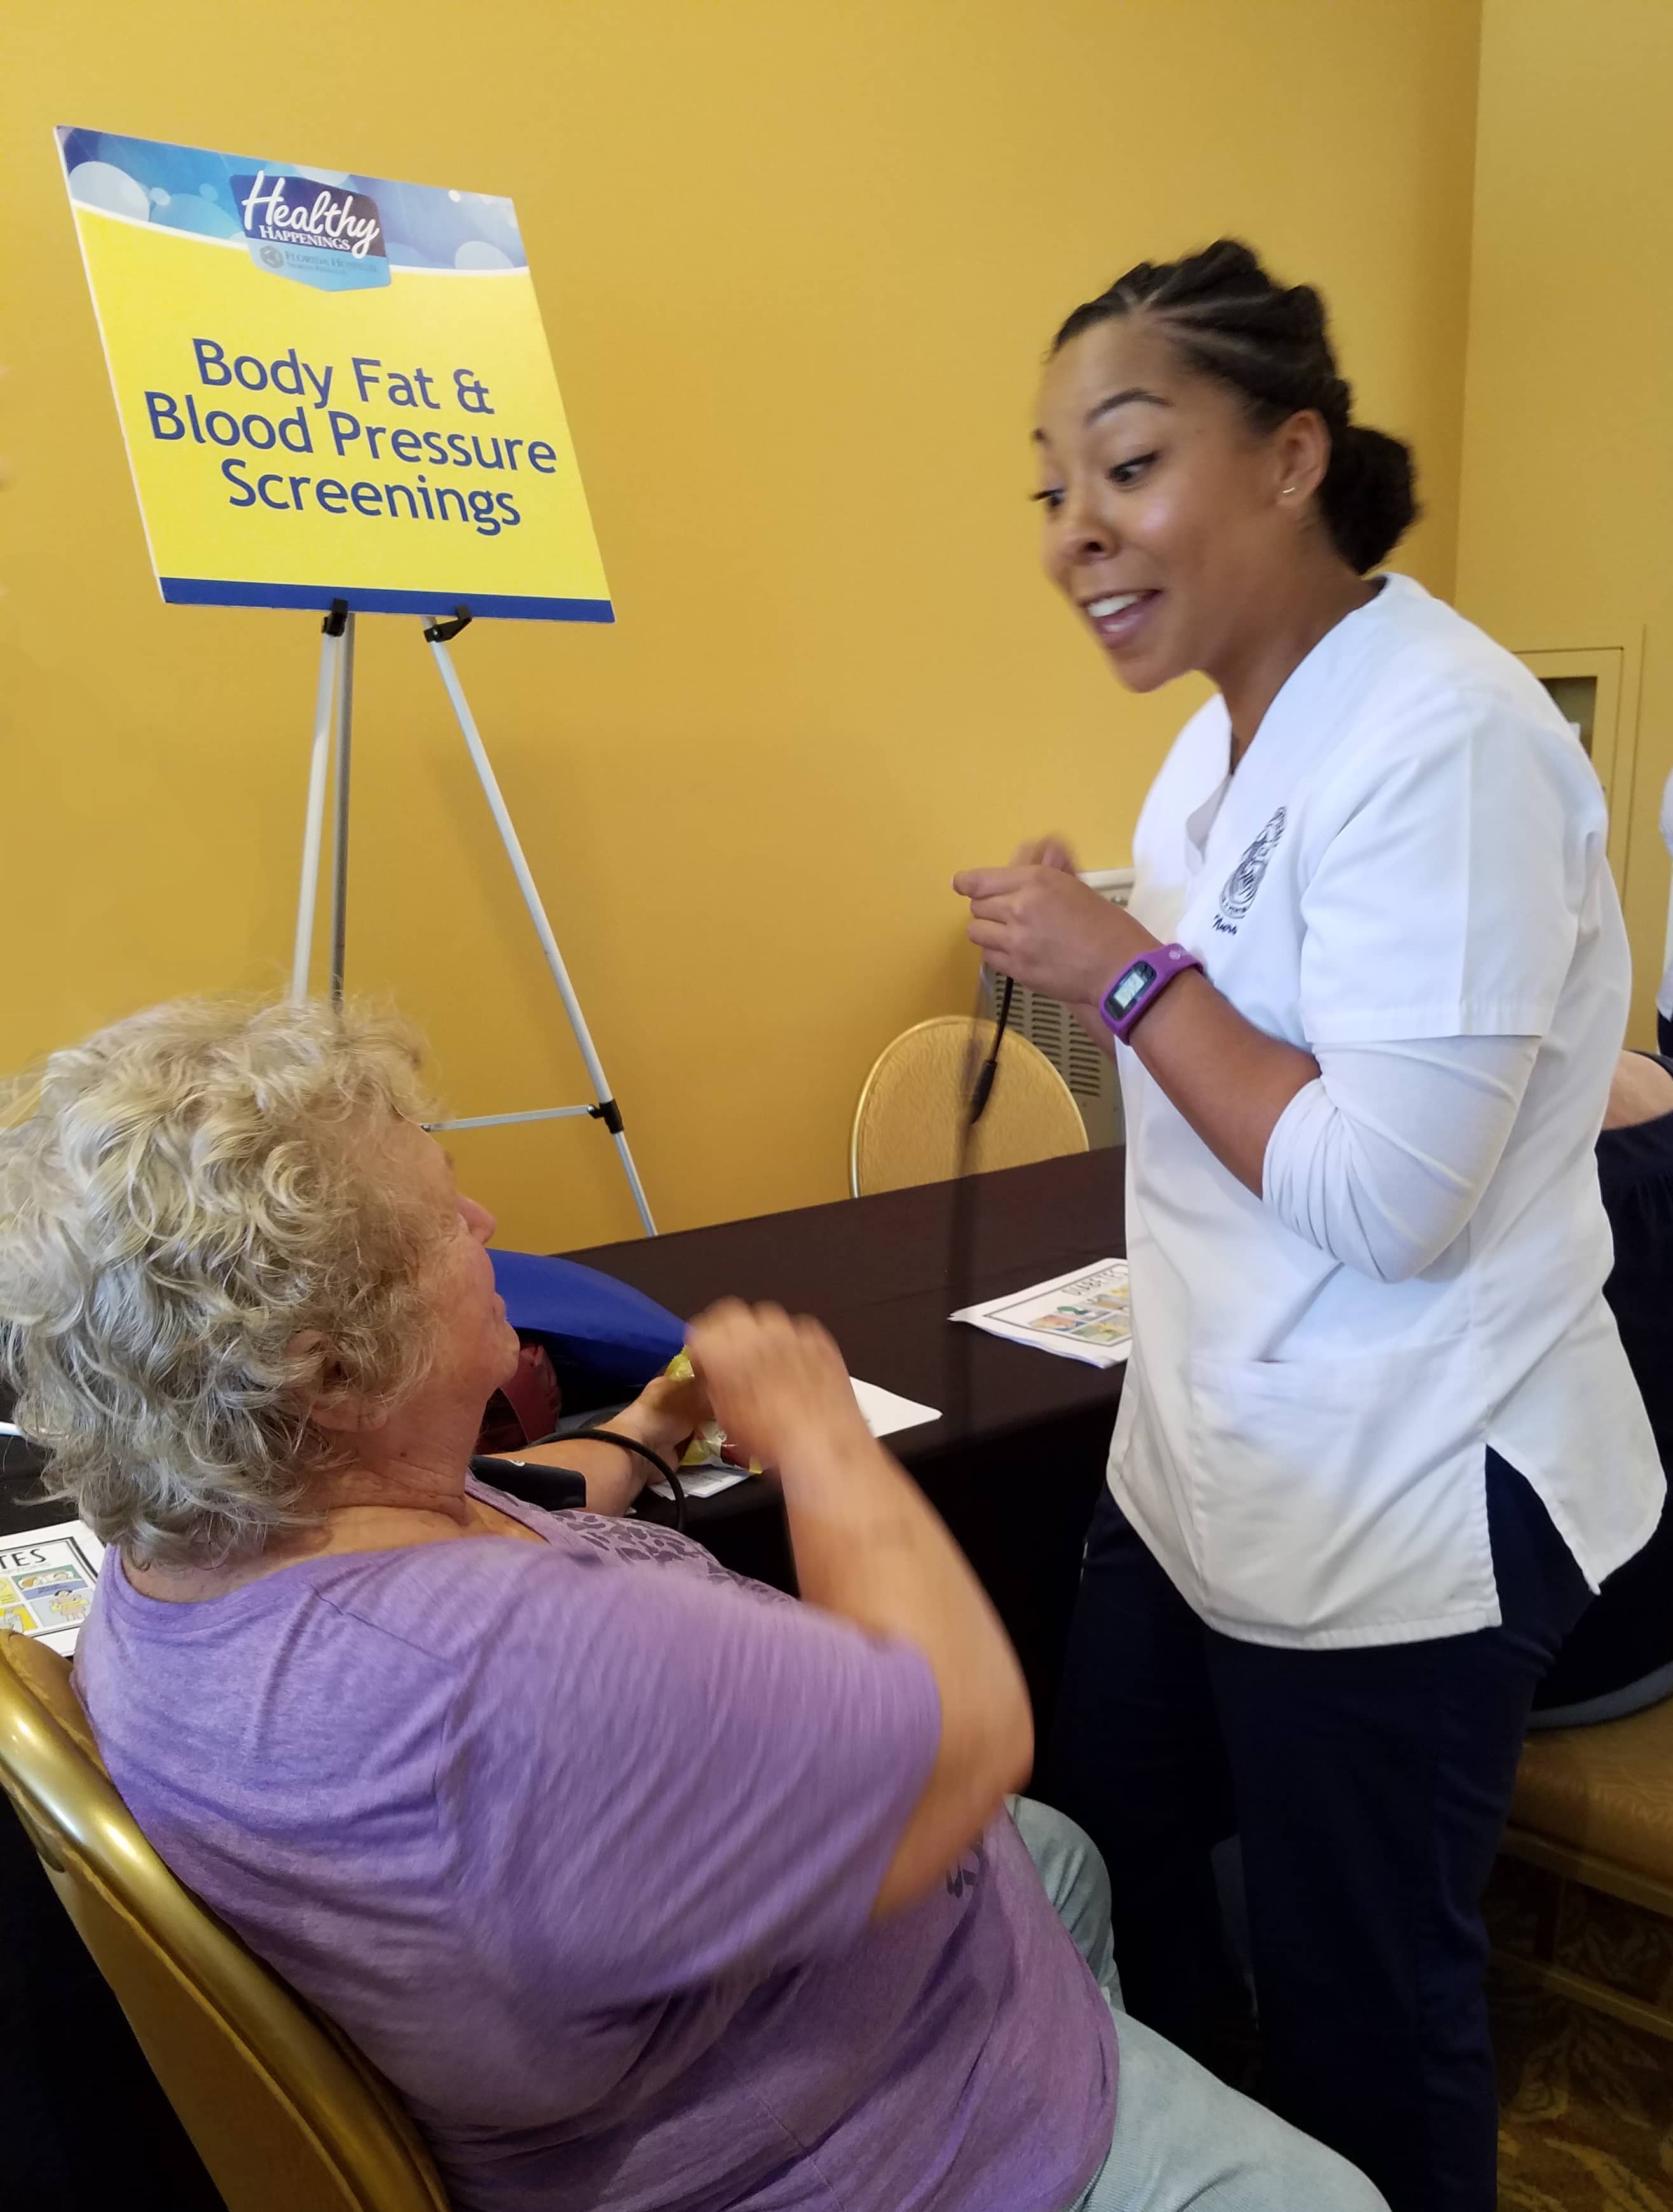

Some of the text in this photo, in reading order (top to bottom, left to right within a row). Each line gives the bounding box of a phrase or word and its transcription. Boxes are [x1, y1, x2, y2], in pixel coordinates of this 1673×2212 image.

[242, 170, 380, 258] Healthy
[258, 225, 351, 250] HAPPENINGS
[193, 338, 495, 415] Body Fat &
[144, 390, 557, 474] Blood Pressure
[221, 458, 521, 536] Screenings
